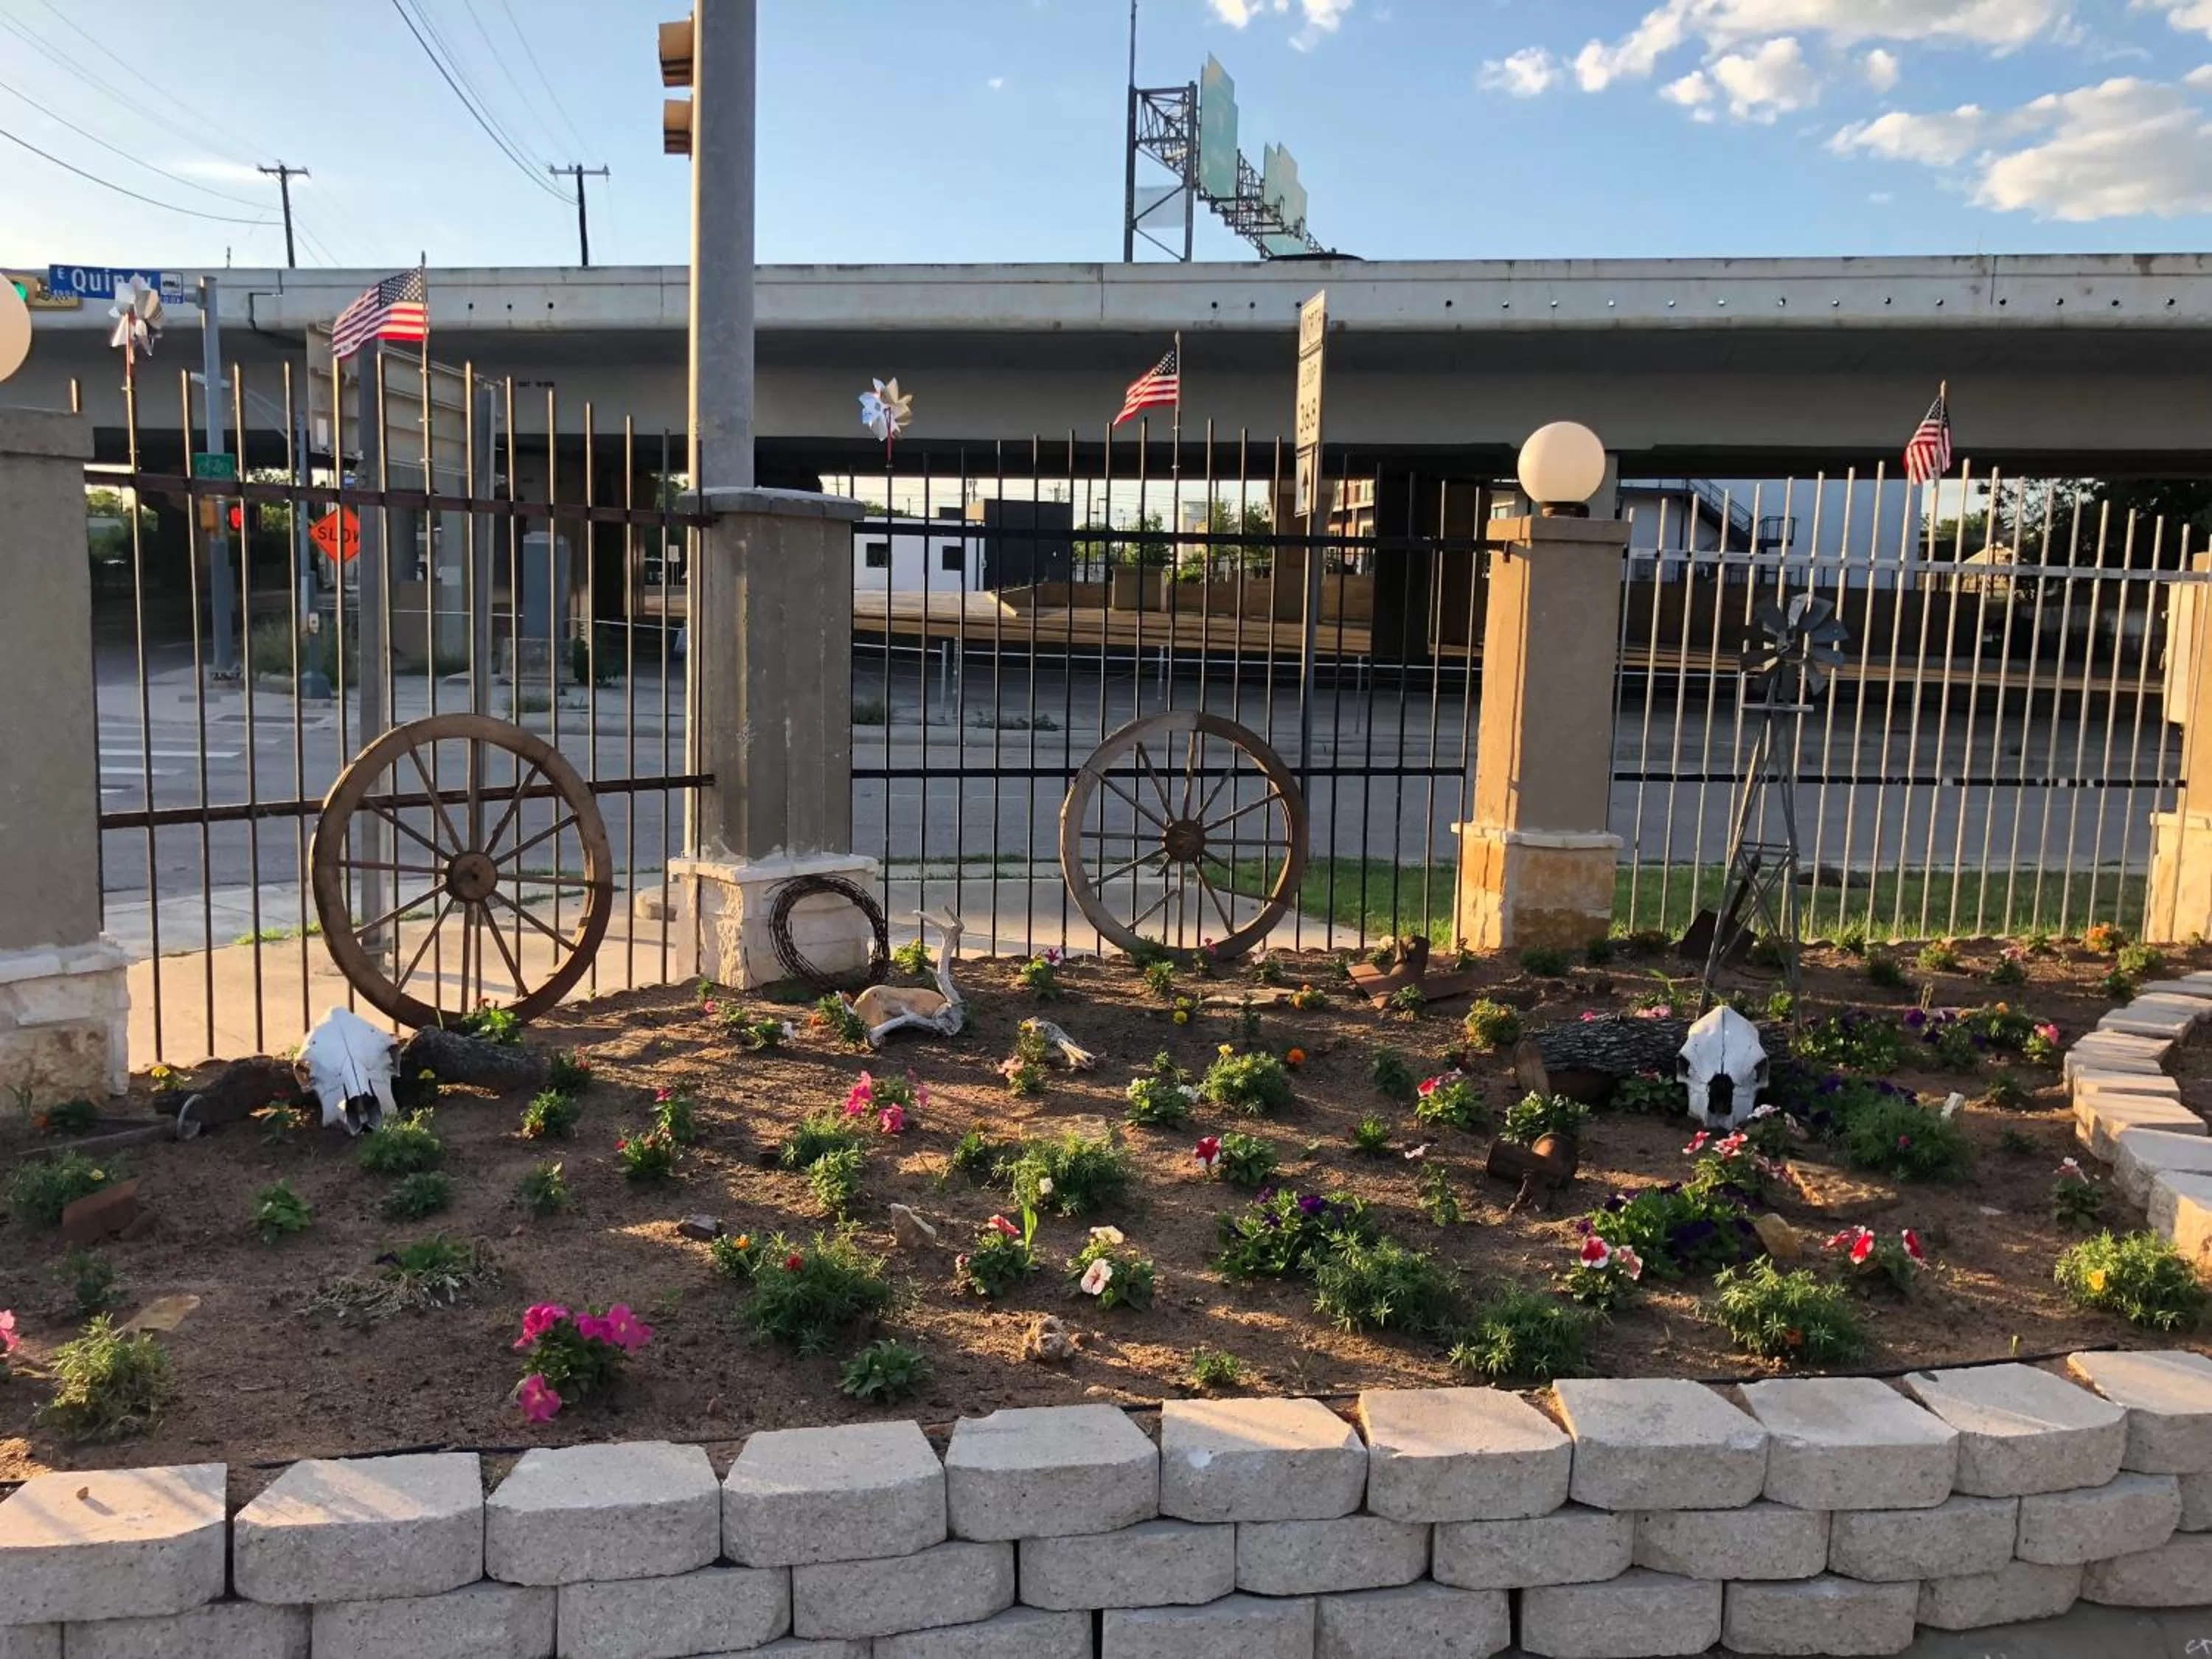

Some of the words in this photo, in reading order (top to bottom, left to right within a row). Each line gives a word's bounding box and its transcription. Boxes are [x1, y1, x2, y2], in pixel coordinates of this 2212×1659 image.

[58, 268, 65, 279] E
[71, 268, 153, 293] Quin
[1299, 398, 1316, 434] 368
